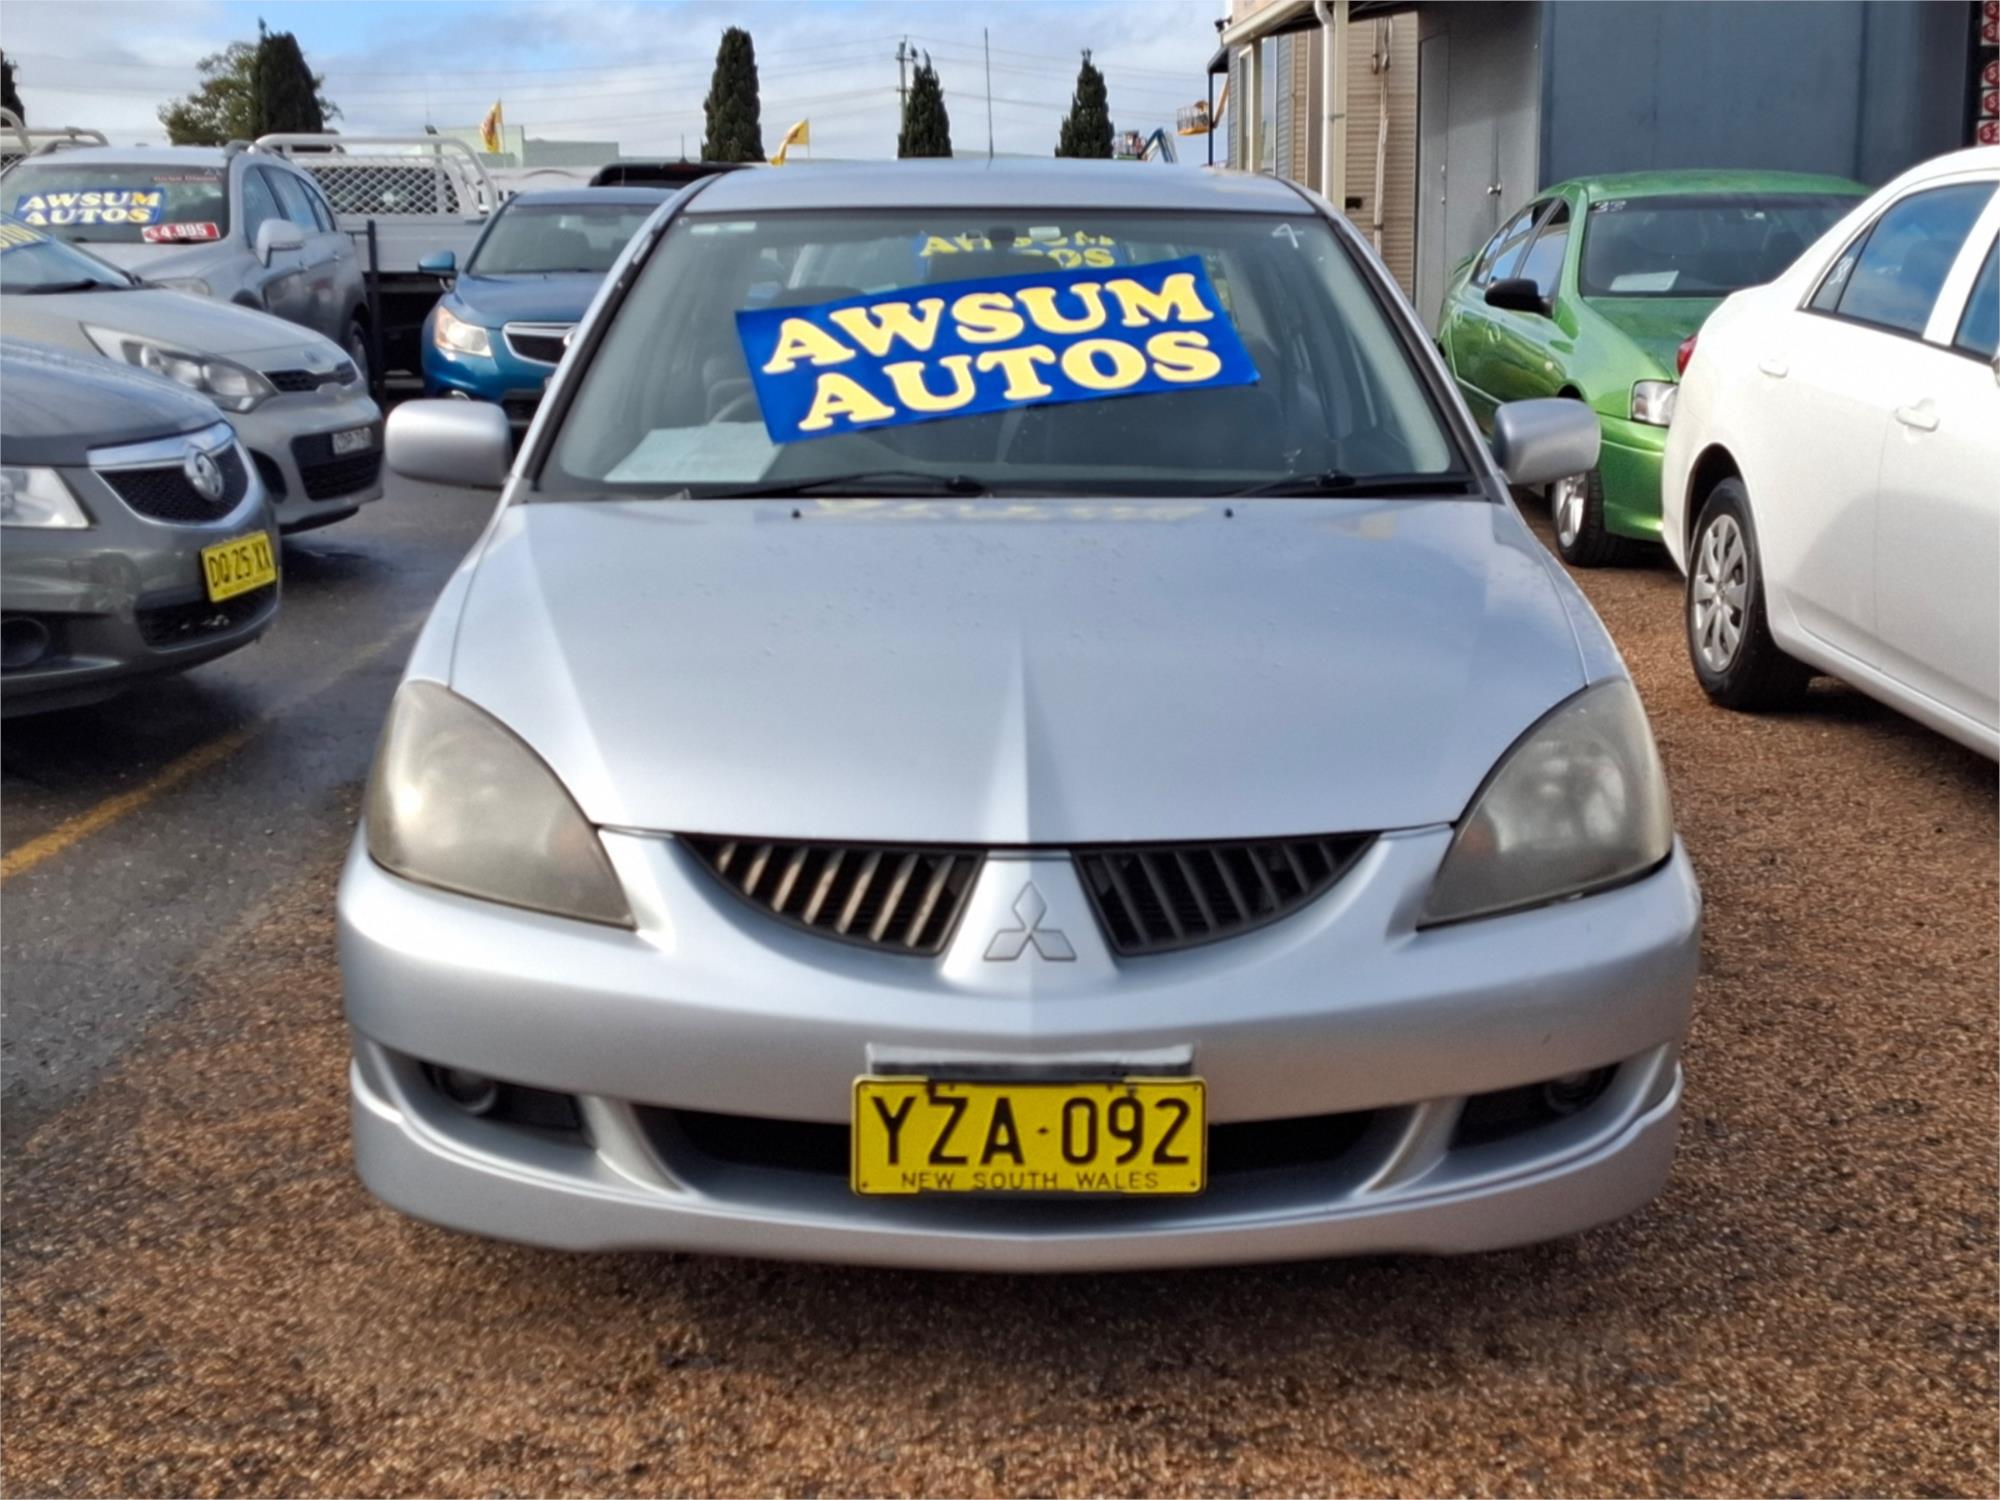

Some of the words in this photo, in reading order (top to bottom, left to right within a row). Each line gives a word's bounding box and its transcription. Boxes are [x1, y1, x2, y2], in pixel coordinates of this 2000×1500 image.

[20, 192, 161, 211] AWSUM
[25, 208, 152, 226] AUTOS
[763, 273, 1214, 374] AWSUM
[799, 331, 1222, 430] AUTOS
[901, 1172, 954, 1189] NEW
[974, 1173, 1057, 1190] SOUTH
[1077, 1172, 1159, 1189] WALES
